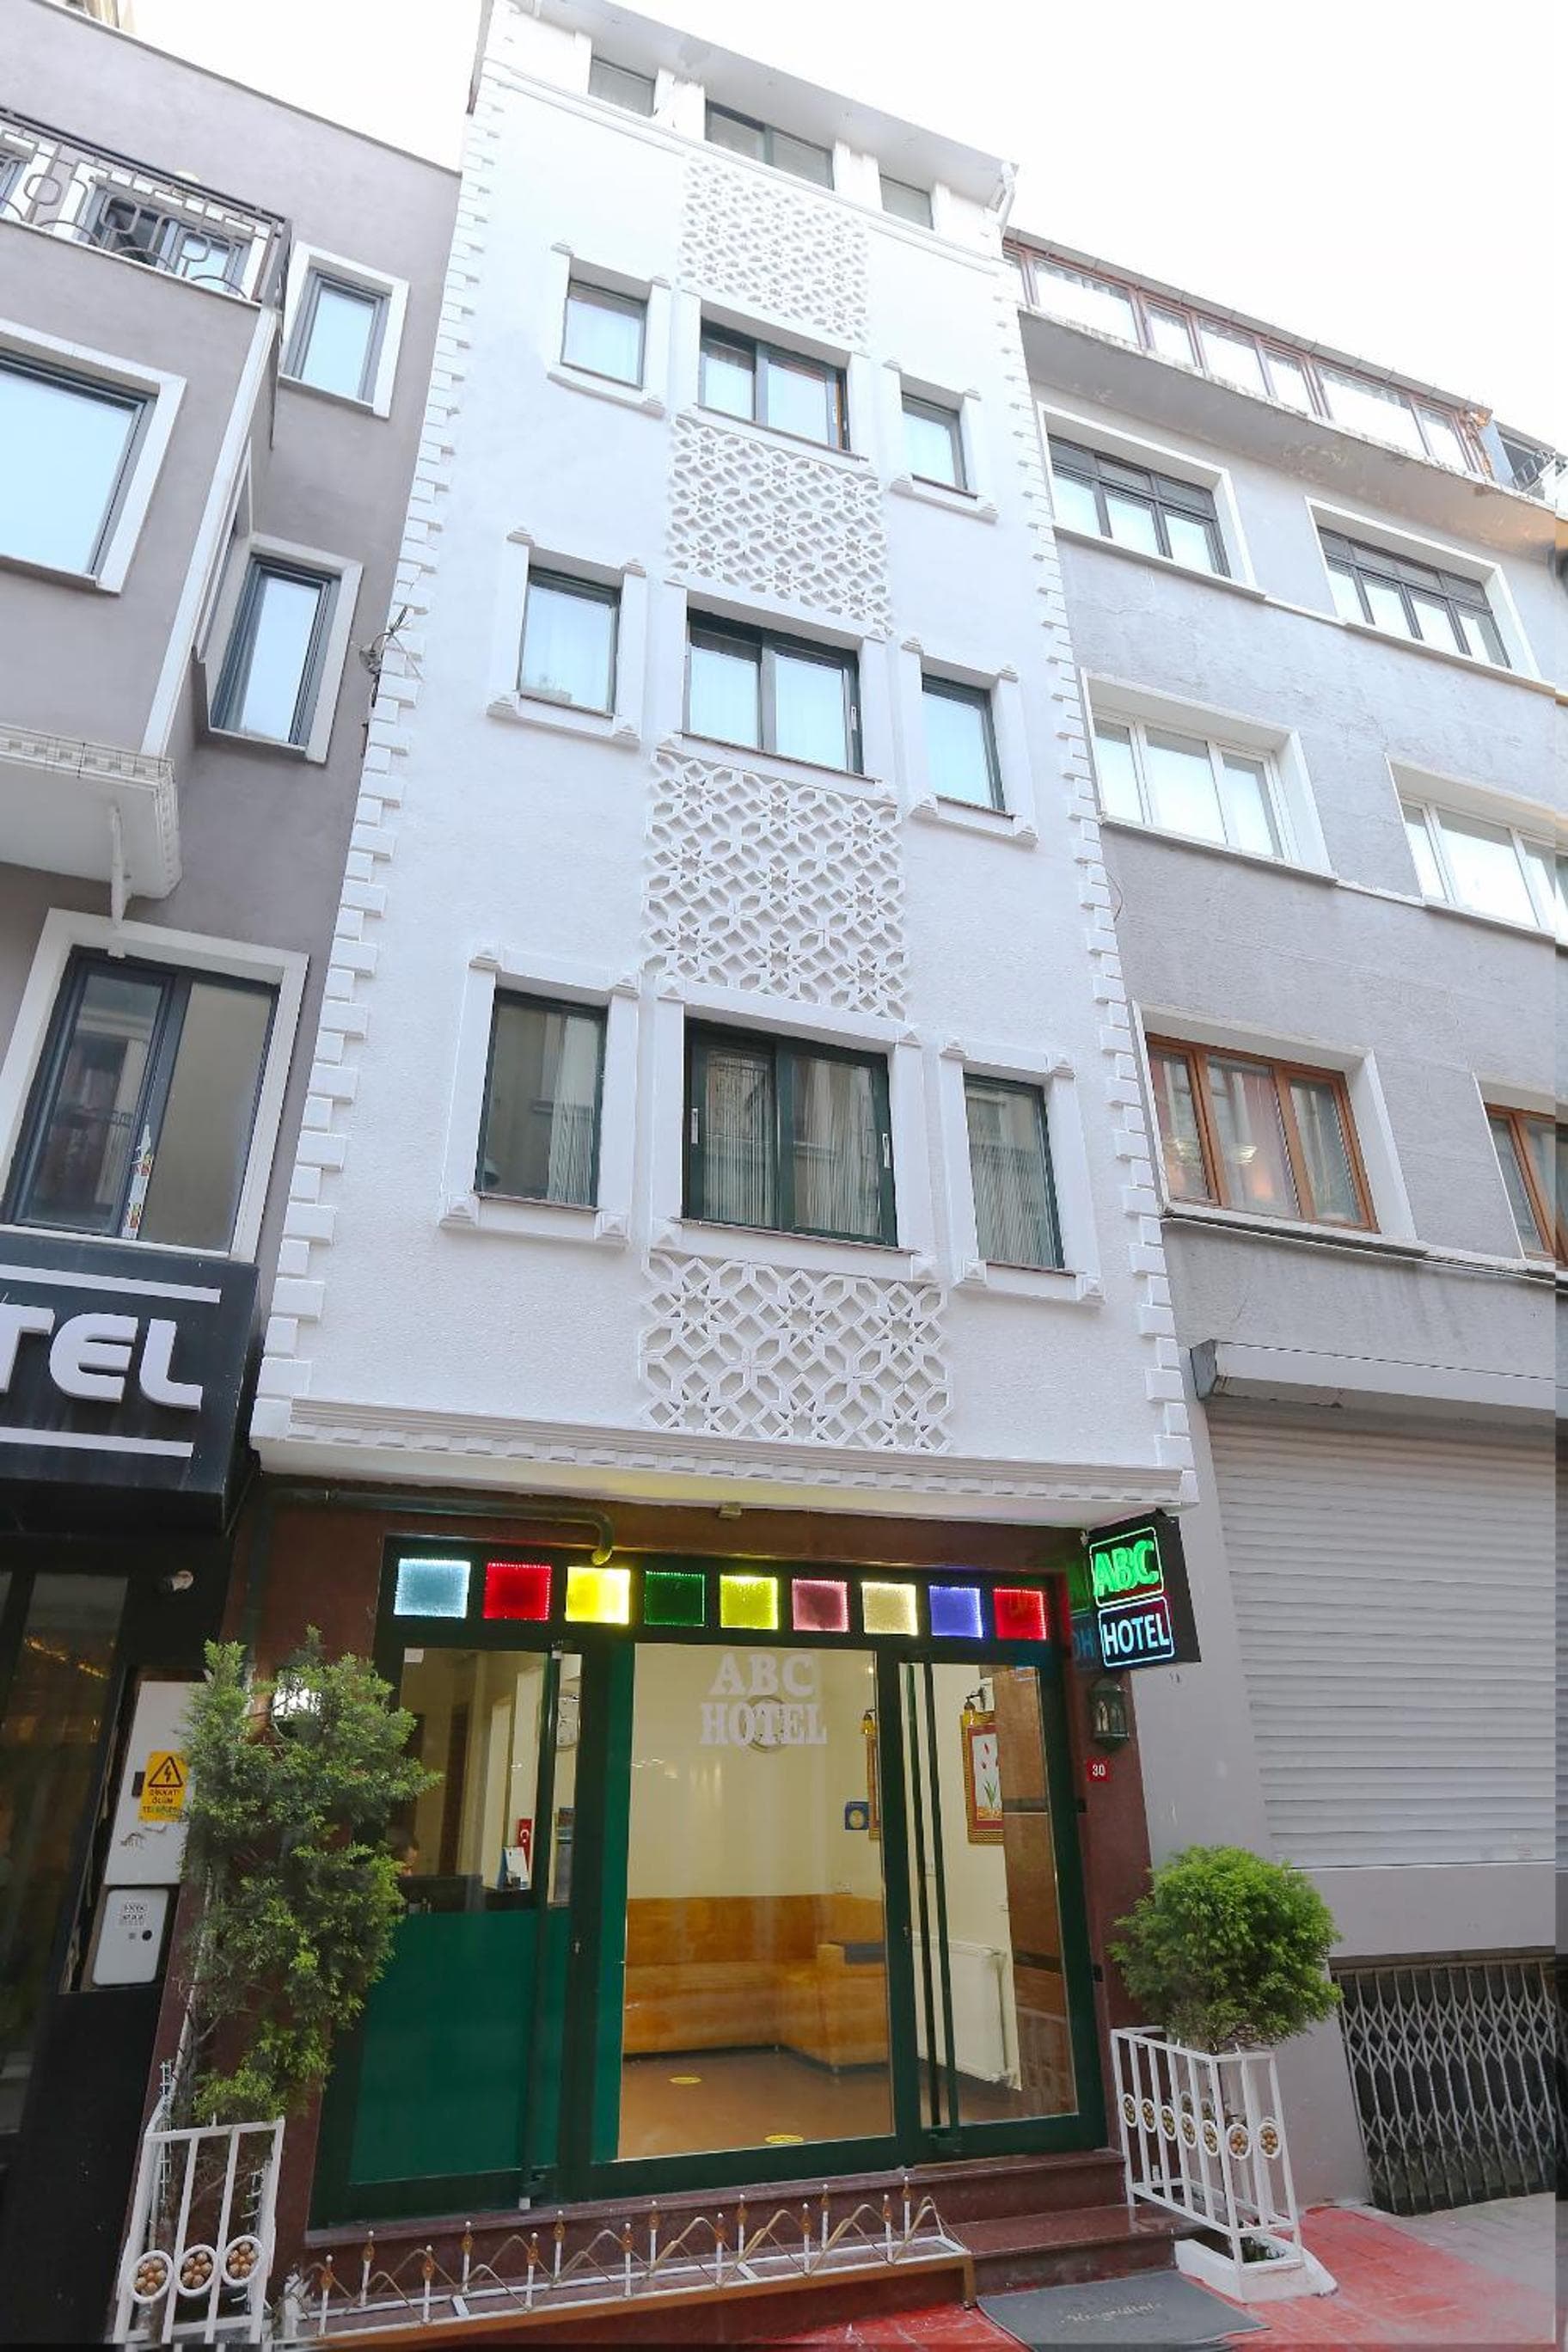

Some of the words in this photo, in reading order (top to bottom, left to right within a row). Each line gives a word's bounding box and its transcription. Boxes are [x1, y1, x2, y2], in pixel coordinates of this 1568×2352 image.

[1093, 1539, 1159, 1596] ABC
[1101, 1613, 1170, 1657] HOTEL
[707, 1652, 815, 1698] ABC
[700, 1700, 828, 1747] HOTEL
[1092, 1763, 1106, 1777] 30
